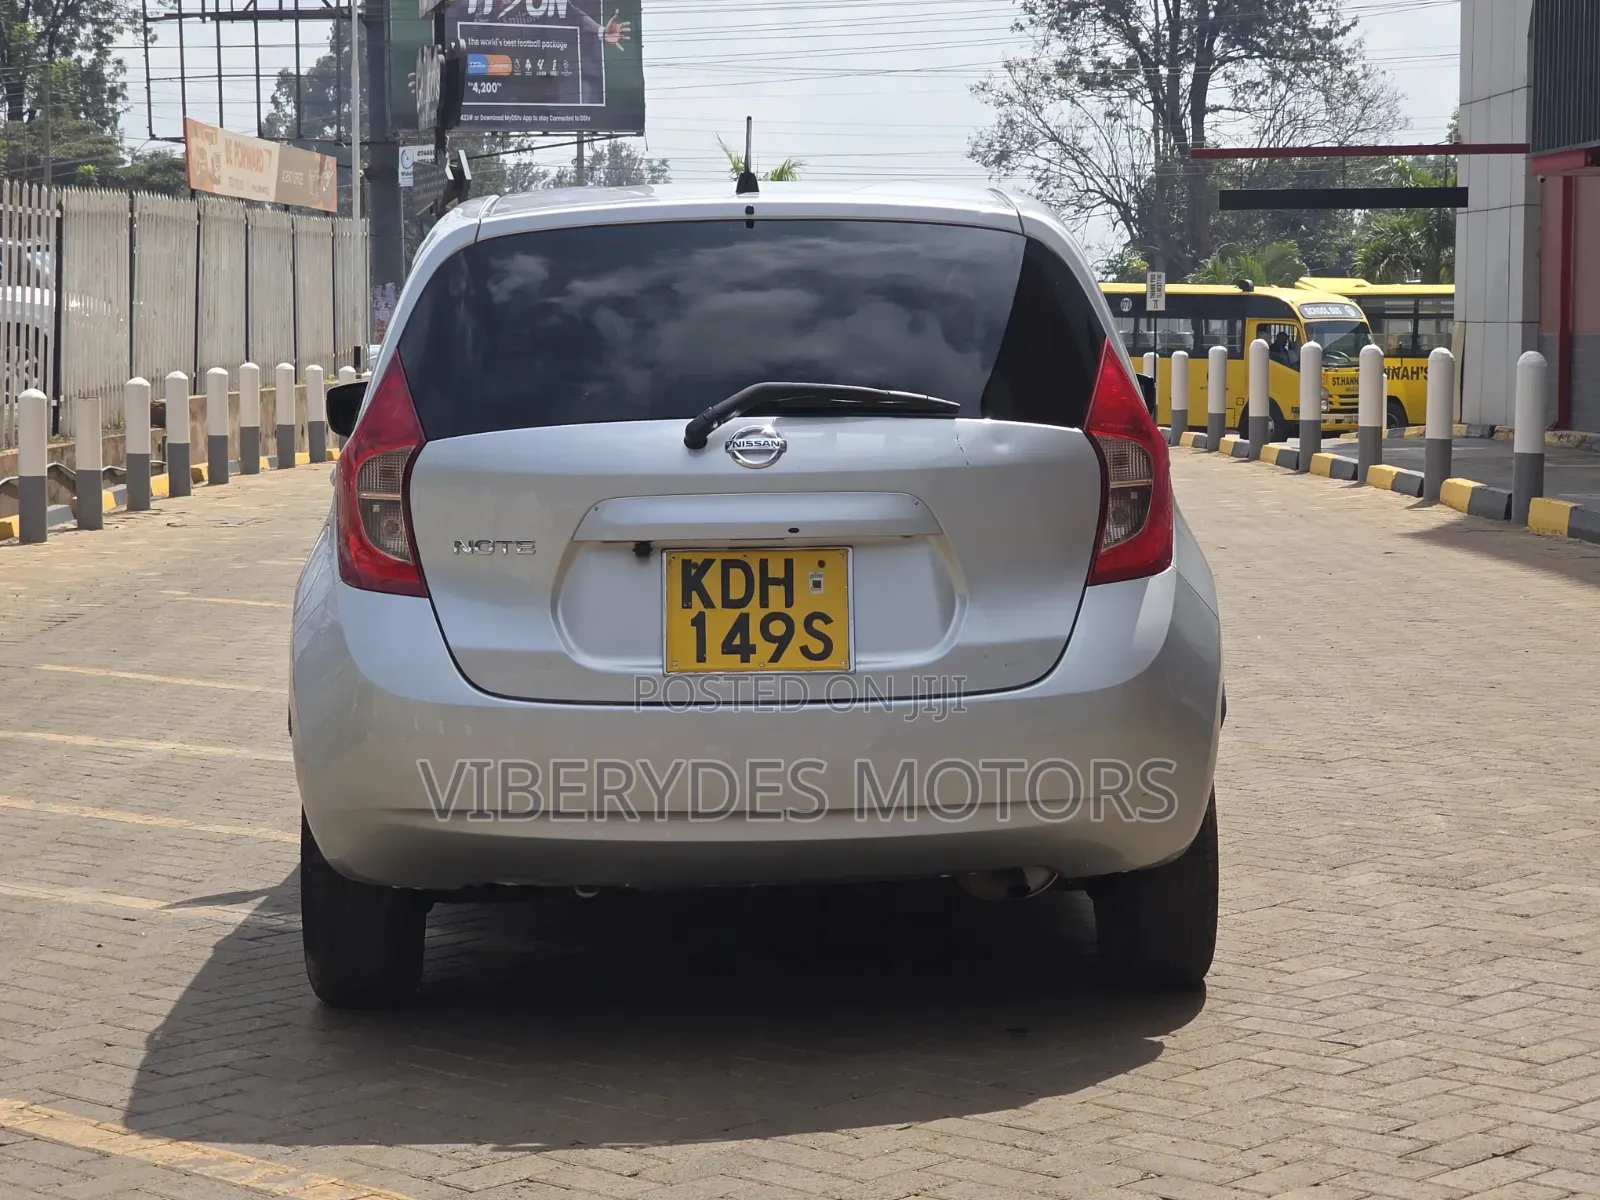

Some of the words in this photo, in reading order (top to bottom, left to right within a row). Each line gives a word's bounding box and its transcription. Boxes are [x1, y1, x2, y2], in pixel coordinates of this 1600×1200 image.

[468, 38, 479, 46] The
[480, 38, 502, 46] world's
[503, 39, 516, 47] best
[517, 39, 541, 48] football
[541, 40, 568, 51] package
[522, 115, 533, 123] App
[1304, 306, 1330, 315] SCHOOL
[1328, 306, 1342, 315] BUS
[1331, 376, 1359, 386] ST.HANN
[732, 440, 780, 449] NISSAN
[453, 540, 537, 556] NOTE
[680, 557, 795, 610] KDH
[690, 610, 835, 664] 149S
